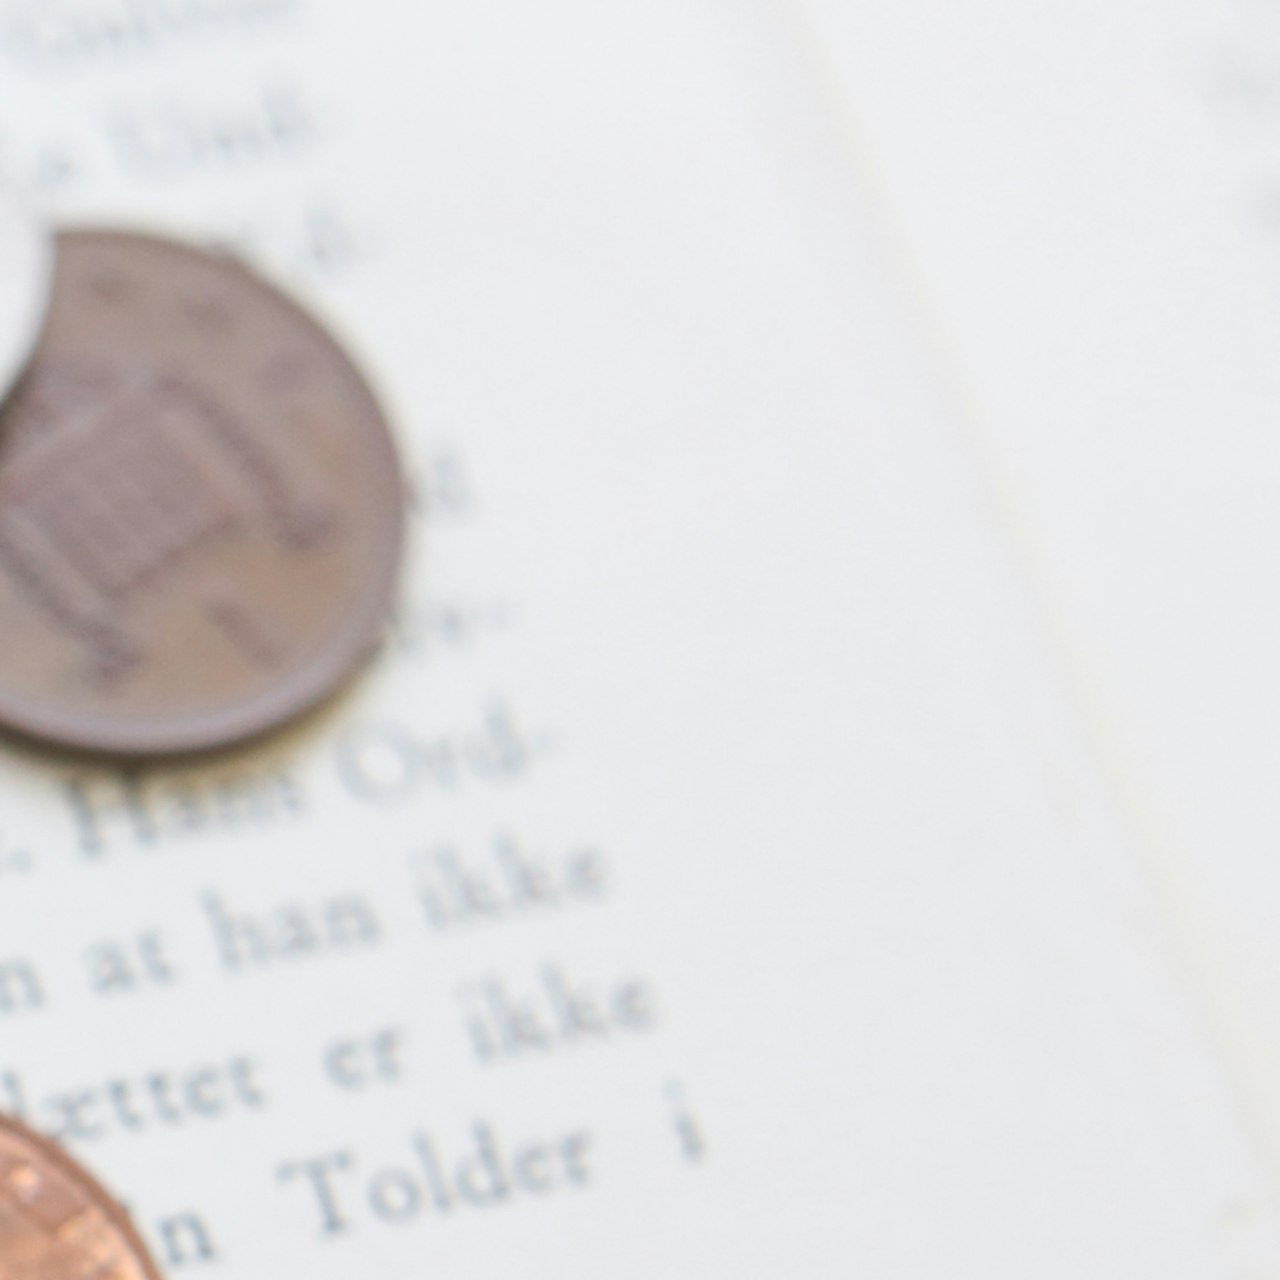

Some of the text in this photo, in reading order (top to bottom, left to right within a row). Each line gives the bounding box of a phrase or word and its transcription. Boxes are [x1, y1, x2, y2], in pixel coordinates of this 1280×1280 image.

[86, 929, 177, 996] at
[200, 890, 383, 974] han
[419, 835, 608, 932] ikke
[322, 1025, 404, 1092] er
[466, 964, 656, 1065] ikke
[276, 1119, 592, 1239] Tolder
[666, 1083, 707, 1166] i
